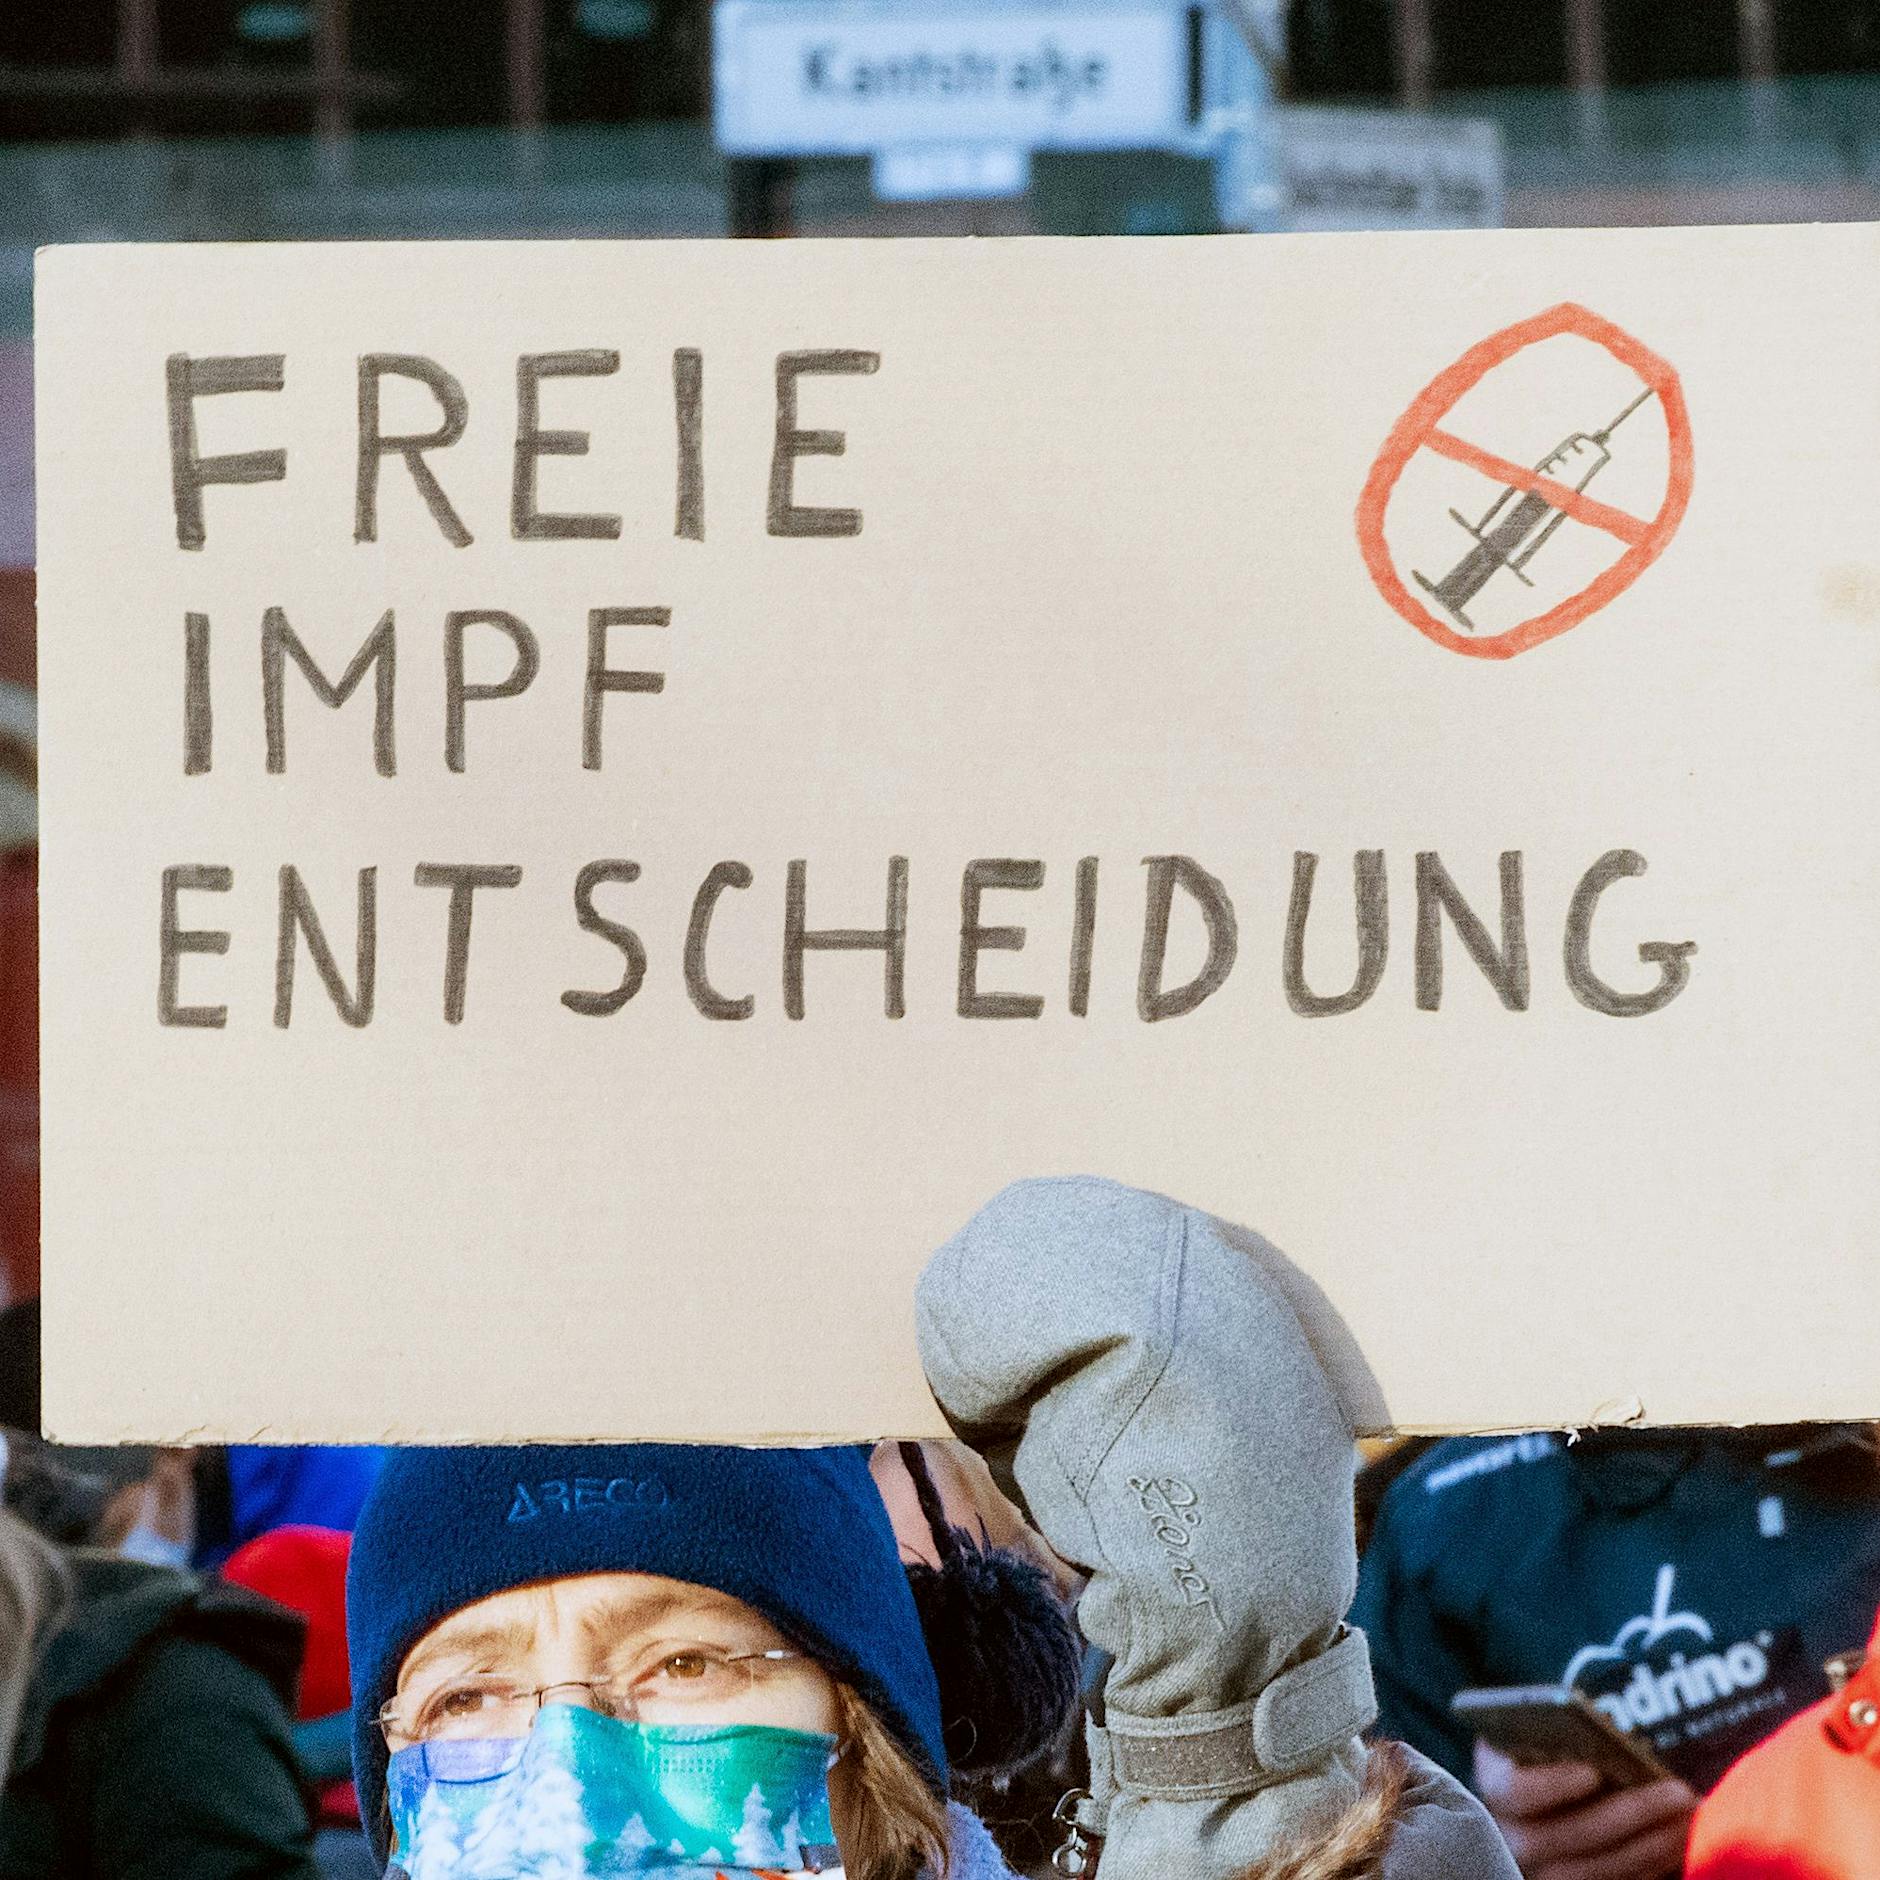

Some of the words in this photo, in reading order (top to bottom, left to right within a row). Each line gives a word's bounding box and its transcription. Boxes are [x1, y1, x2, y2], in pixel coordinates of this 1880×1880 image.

[801, 38, 1109, 113] Kantstraße
[164, 347, 881, 552] FREIE
[184, 605, 672, 779] IMPF
[158, 848, 1697, 1030] ENTSCHEIDUNG
[1595, 1640, 1767, 1733] ndrino
